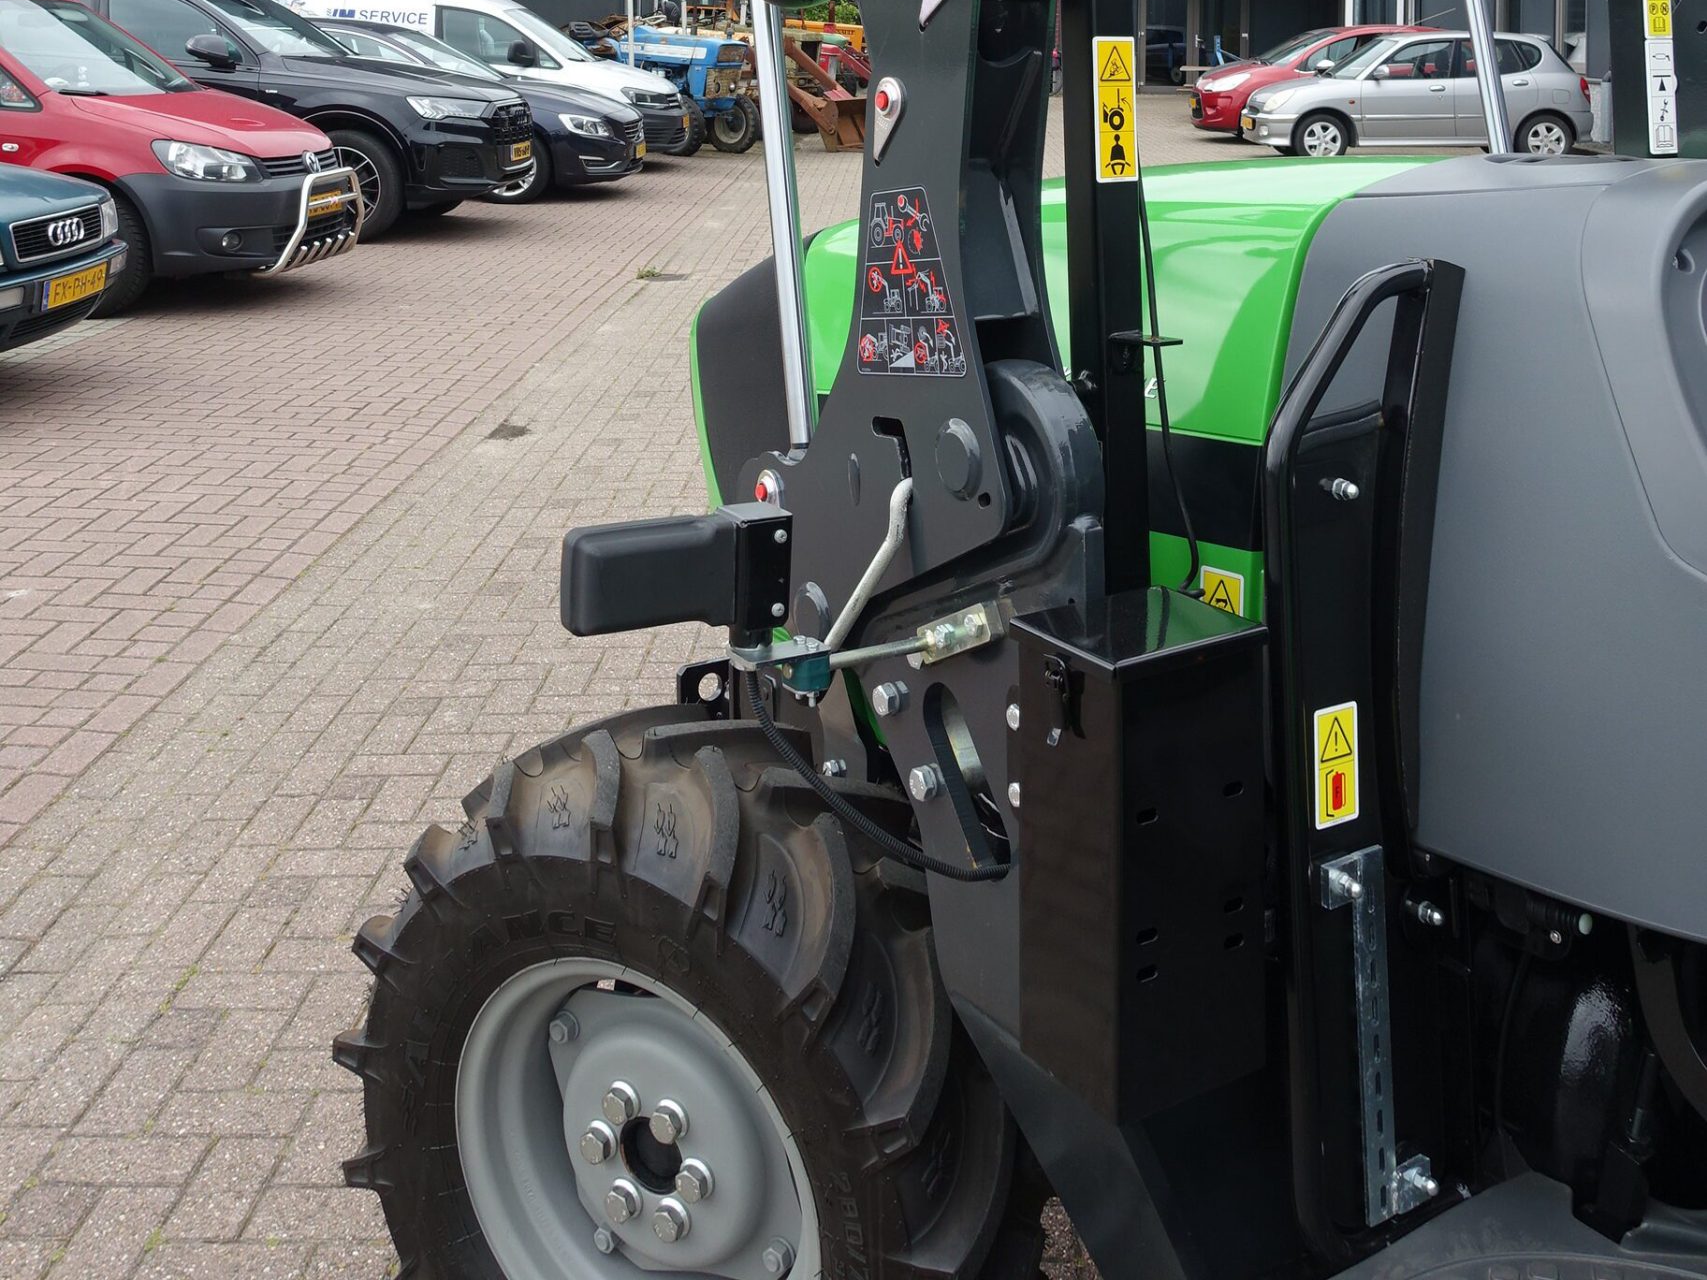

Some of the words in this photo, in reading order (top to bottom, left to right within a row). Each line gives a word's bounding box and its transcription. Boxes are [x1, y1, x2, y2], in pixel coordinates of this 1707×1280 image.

[359, 9, 428, 25] SERVICE
[53, 269, 103, 303] FX-PH-49
[403, 908, 617, 1090] AIANCE
